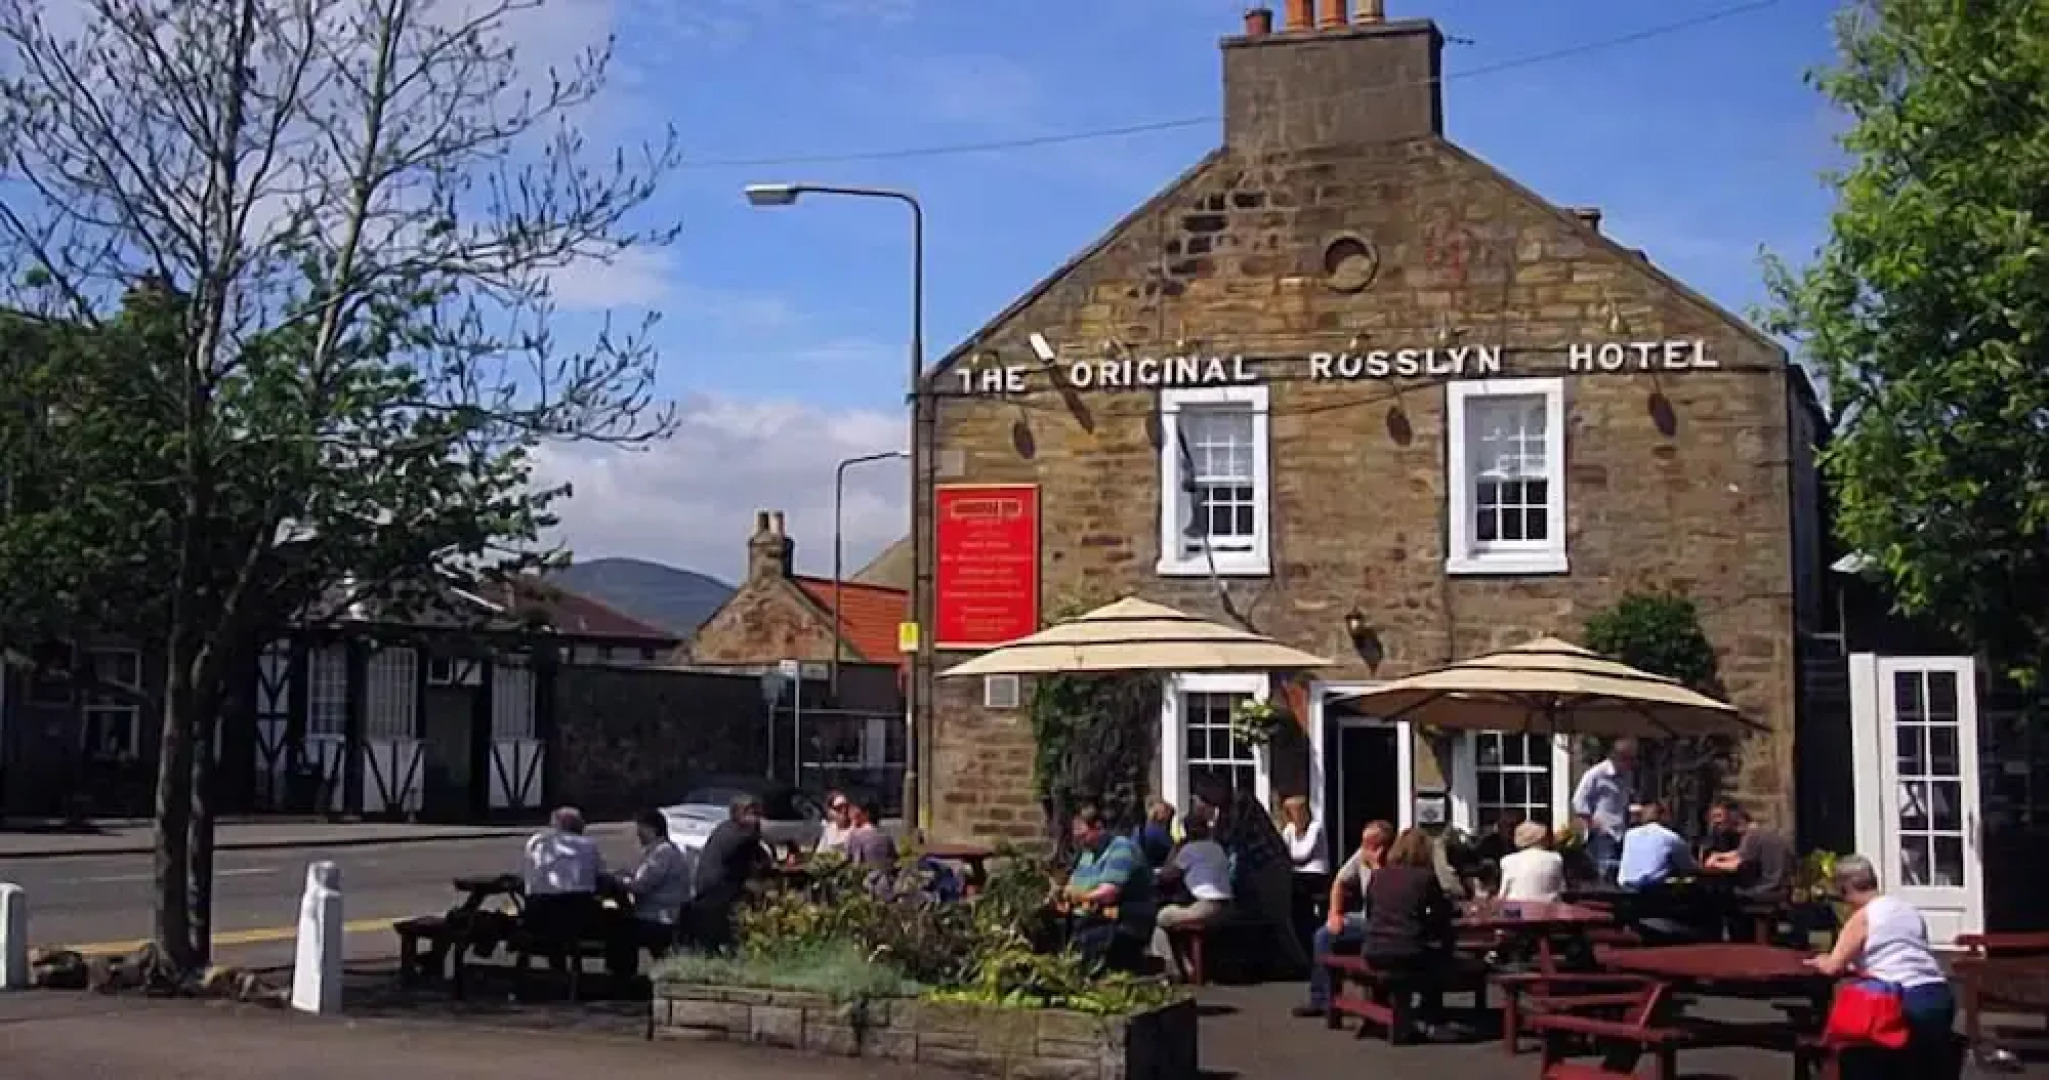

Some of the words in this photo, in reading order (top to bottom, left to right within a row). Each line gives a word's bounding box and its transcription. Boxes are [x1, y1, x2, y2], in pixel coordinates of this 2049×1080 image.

[955, 364, 1027, 394] THE
[1070, 355, 1257, 387] ORIGINAL
[1309, 344, 1502, 379] ROSSLYN
[1567, 339, 1719, 371] HOTEL
